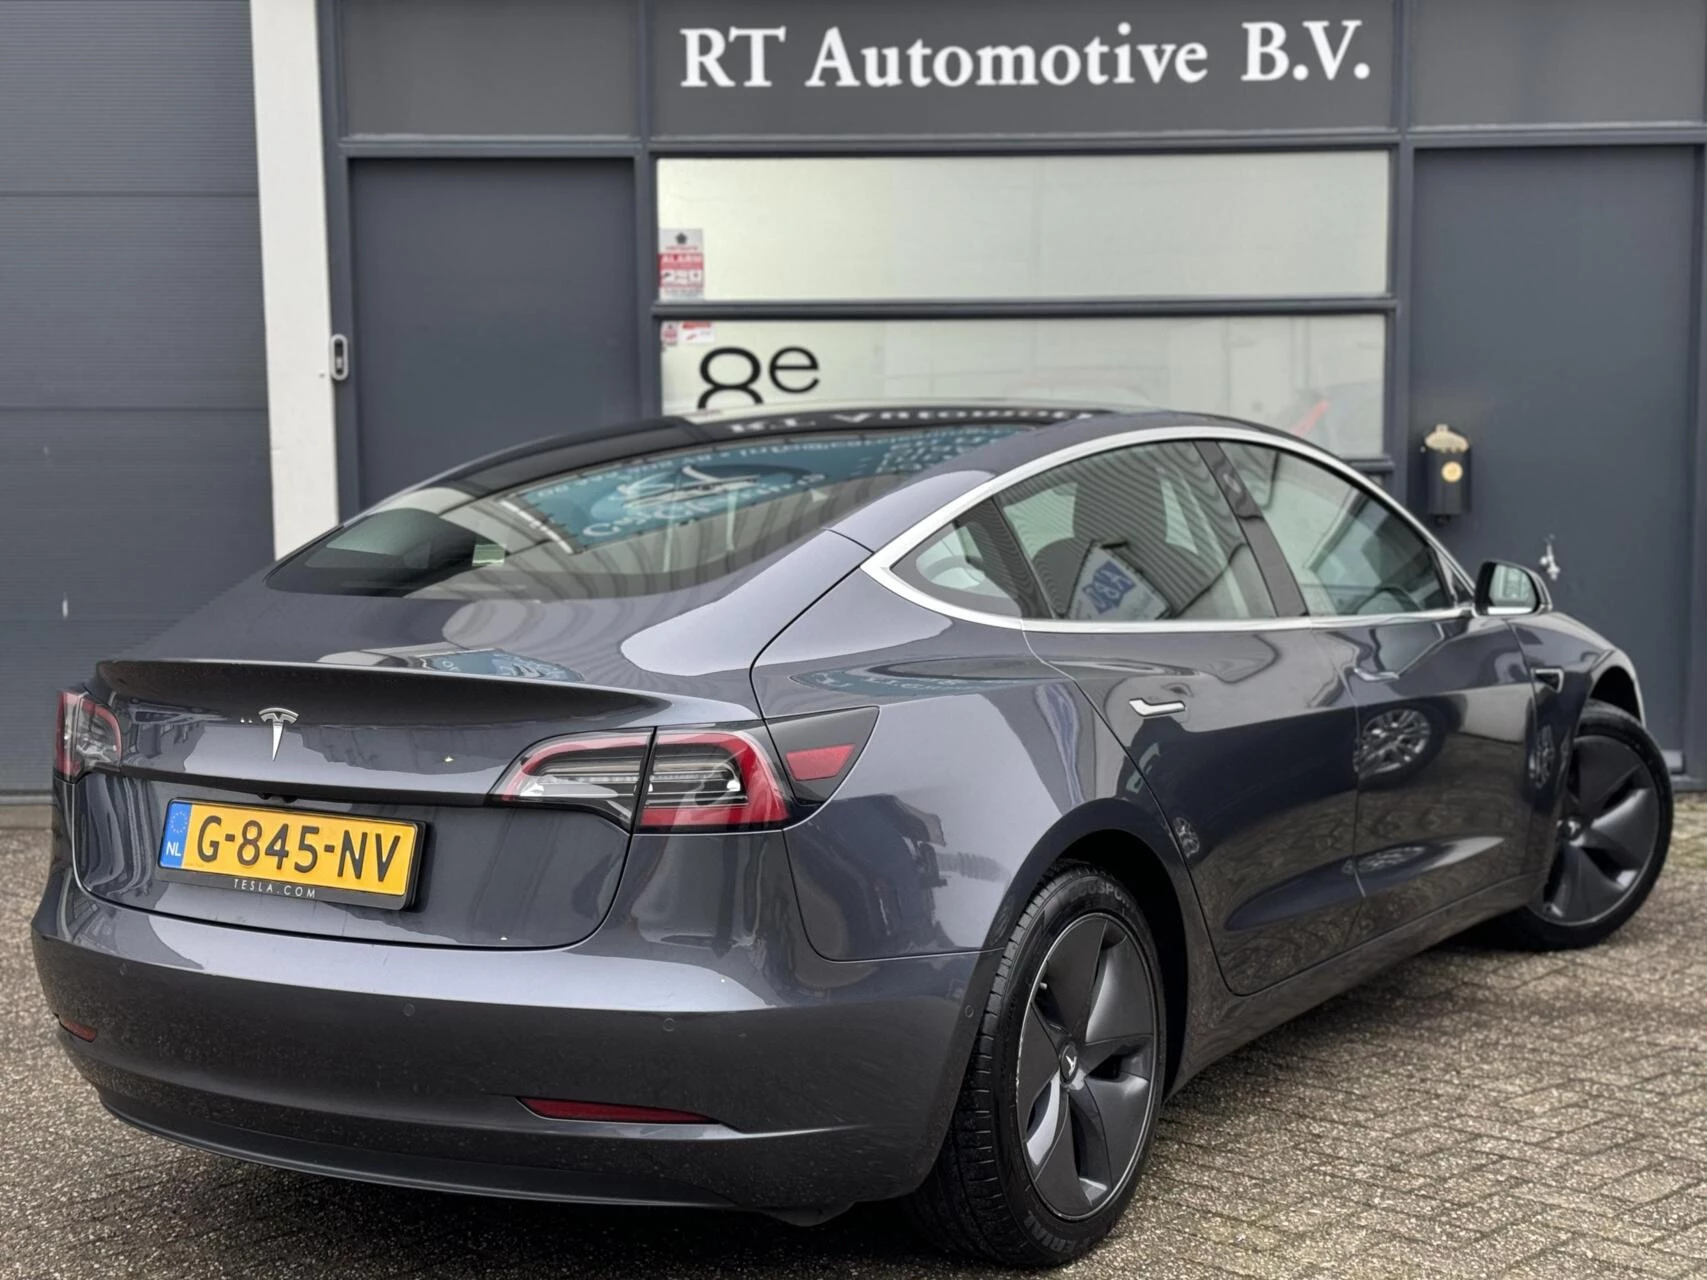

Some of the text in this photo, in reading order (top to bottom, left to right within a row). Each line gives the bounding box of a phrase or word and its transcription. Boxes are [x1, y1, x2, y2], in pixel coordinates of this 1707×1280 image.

[680, 20, 1371, 88] RT Automotive B.V.
[165, 841, 182, 858] NL
[197, 815, 401, 882] G-845-NV
[233, 878, 317, 898] TESLA.COM
